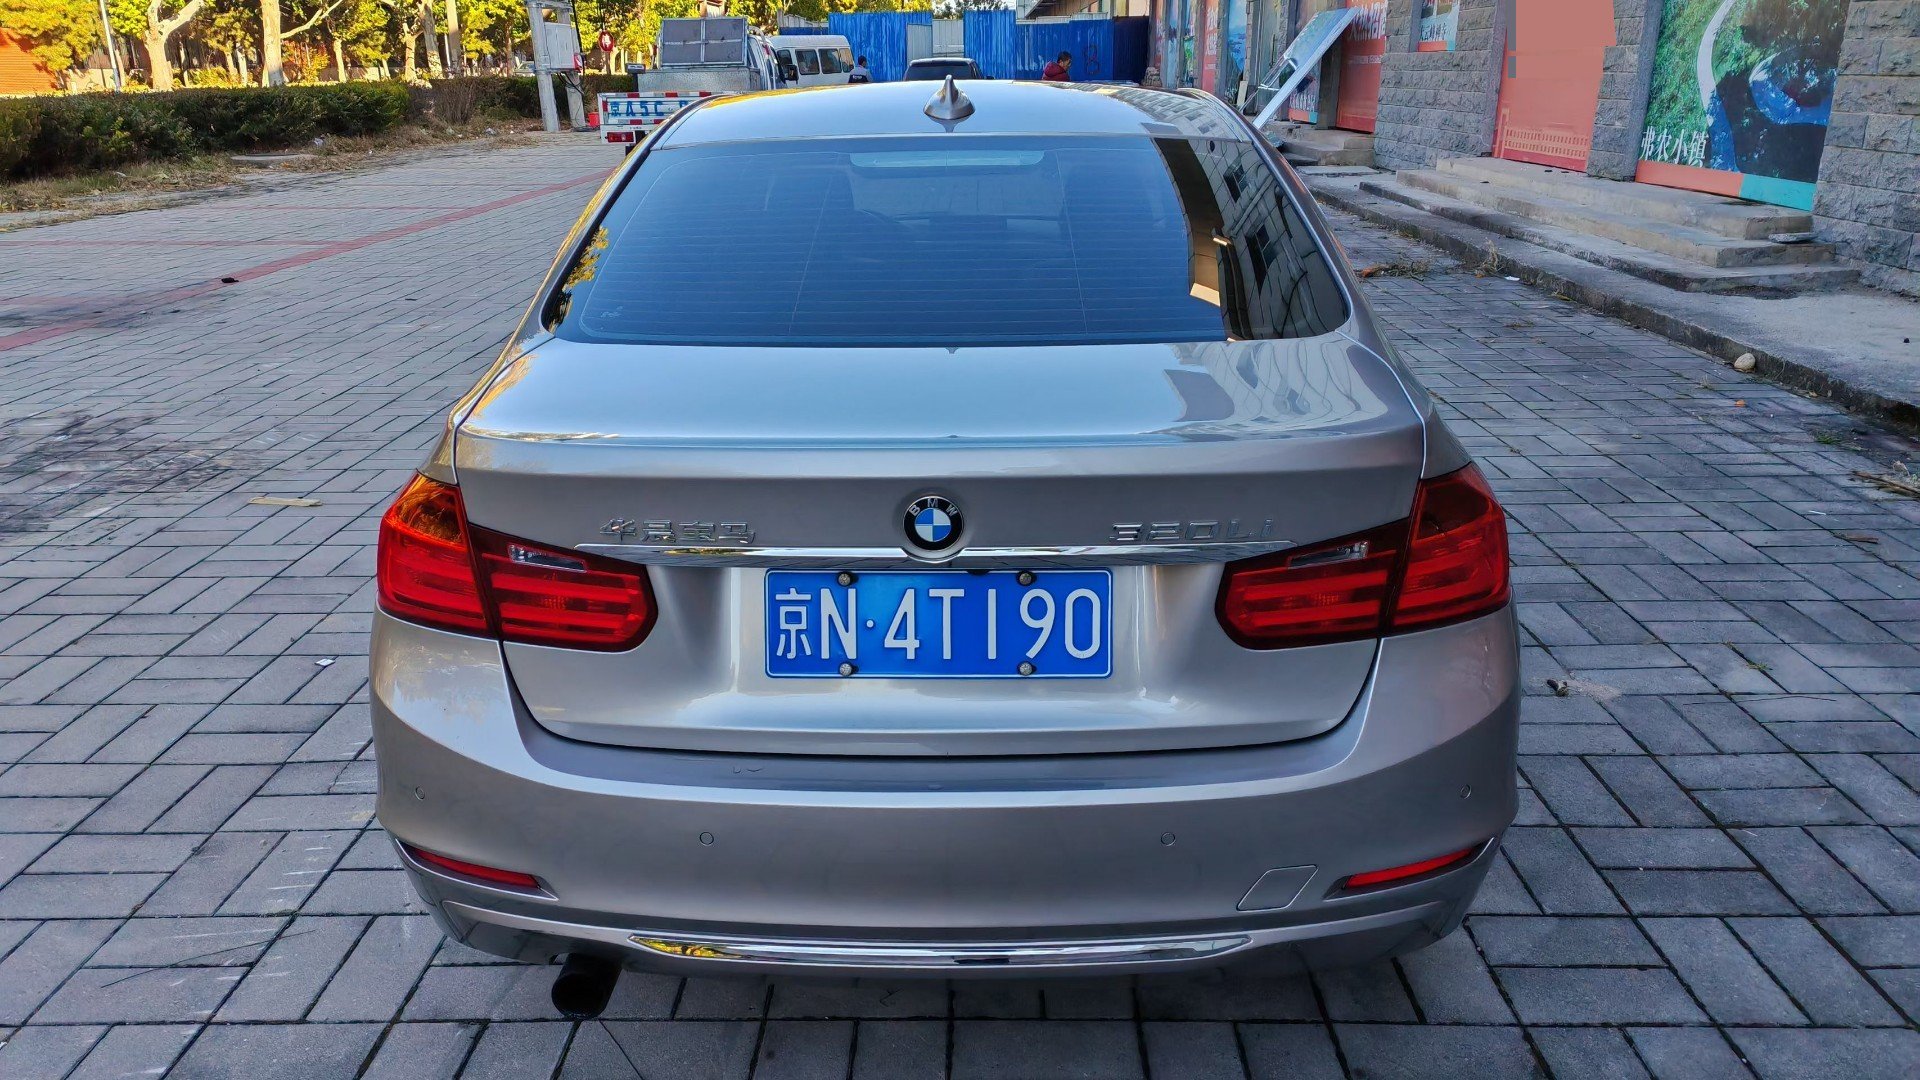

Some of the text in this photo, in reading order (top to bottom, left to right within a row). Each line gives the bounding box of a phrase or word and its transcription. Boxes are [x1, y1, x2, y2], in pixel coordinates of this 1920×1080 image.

[909, 498, 958, 516] BMW
[600, 518, 756, 544] 华晨宝马
[1109, 519, 1274, 541] 320Li
[775, 587, 1101, 660] 京N·4T190
